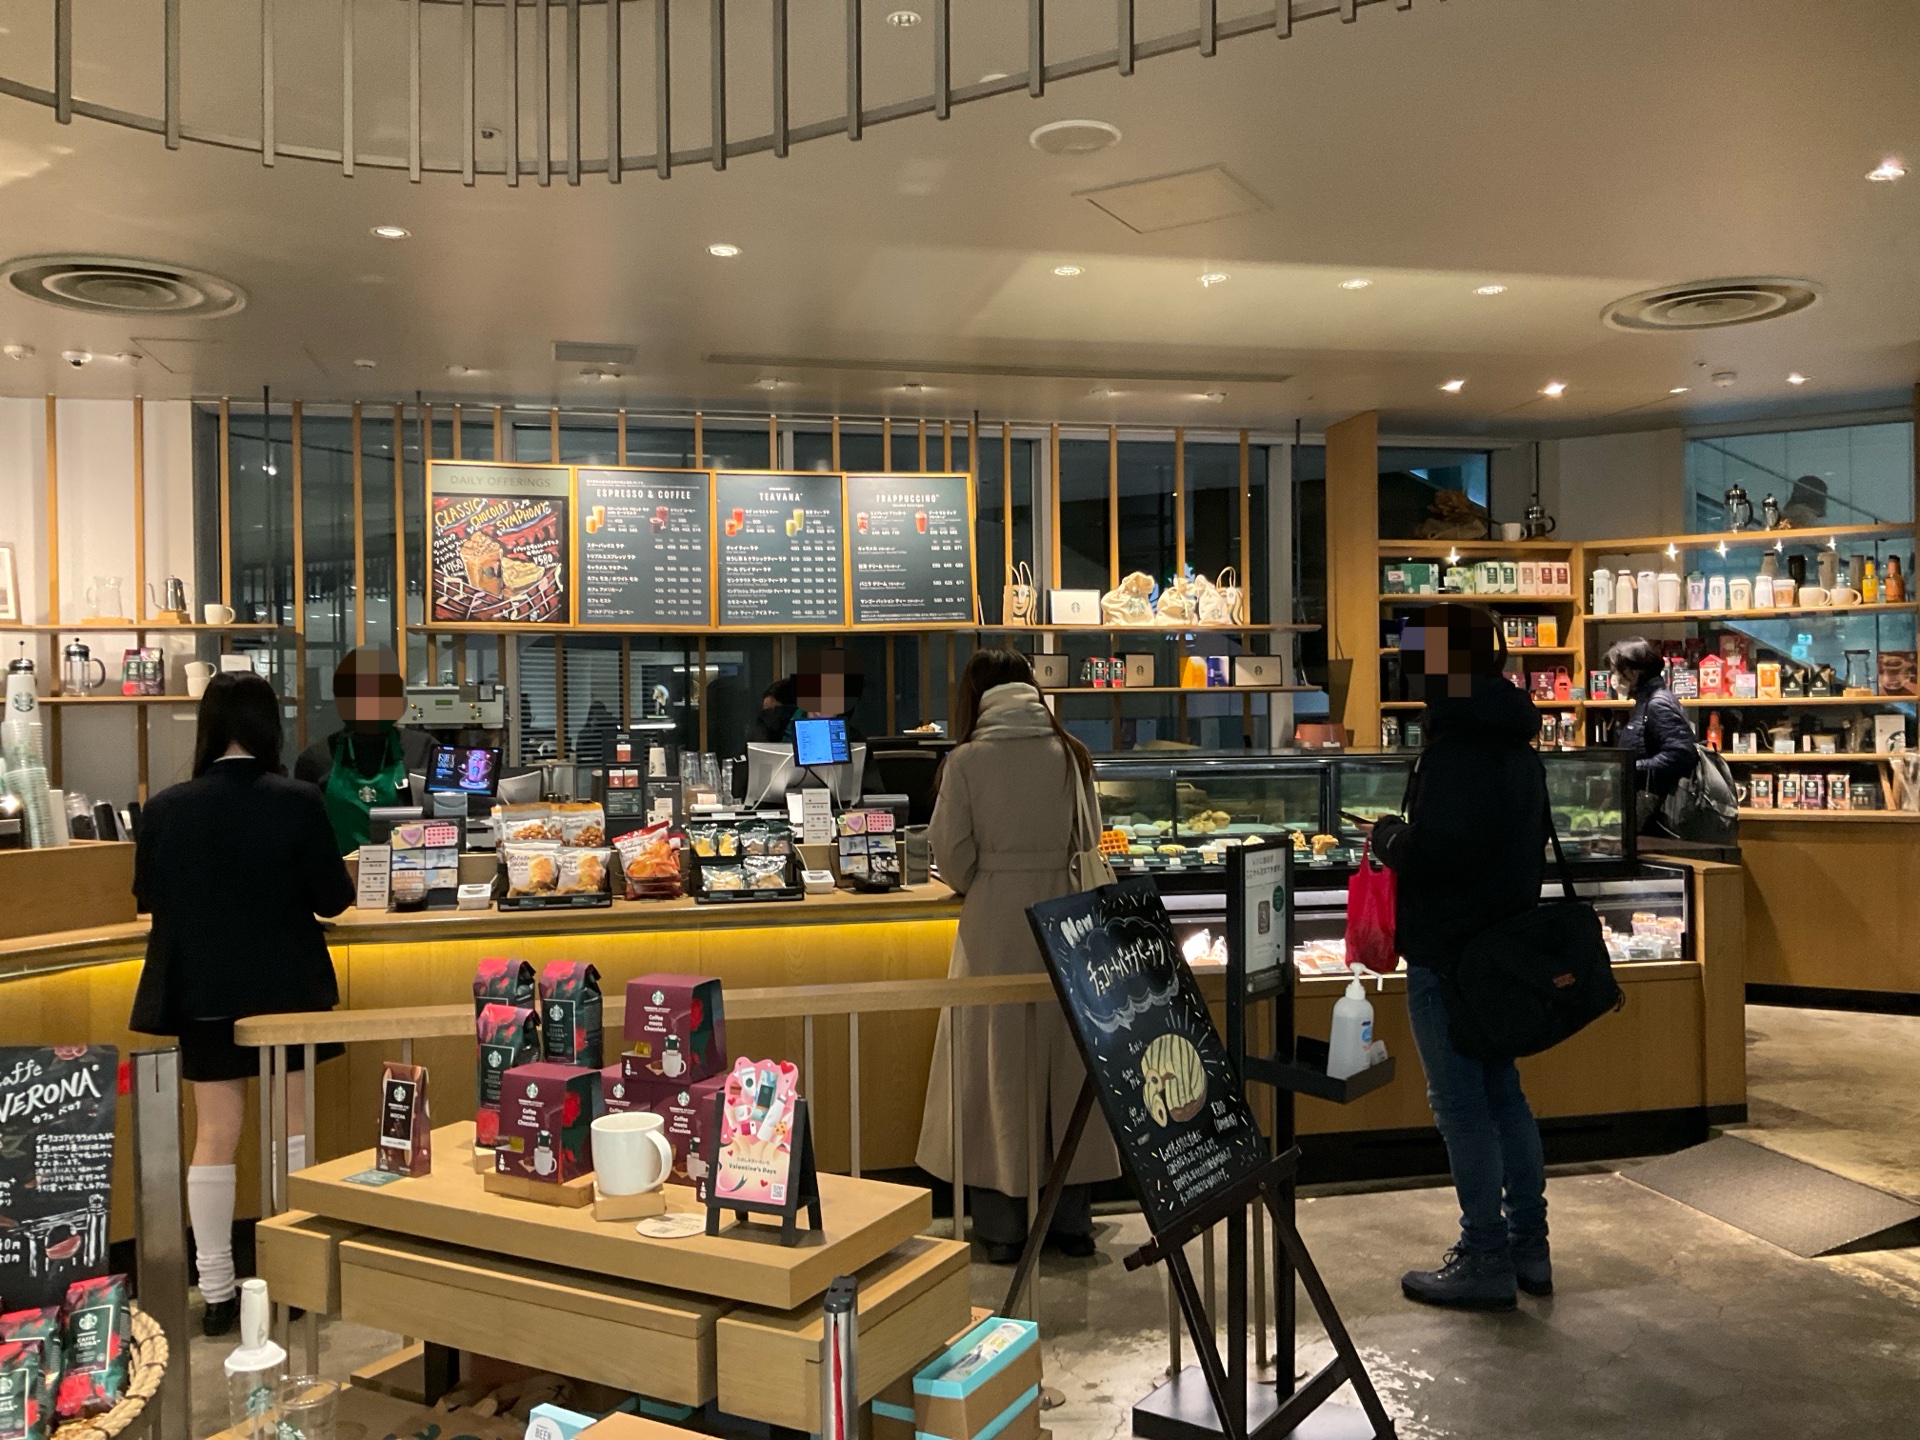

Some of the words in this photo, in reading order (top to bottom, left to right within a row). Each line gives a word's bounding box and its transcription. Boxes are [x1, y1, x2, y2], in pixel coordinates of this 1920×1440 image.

[450, 475, 483, 485] DAILY
[487, 477, 551, 487] OFFERINGS
[596, 488, 643, 498] ESPRESSO
[647, 490, 654, 499] &
[657, 490, 691, 500] COFFEE
[759, 492, 800, 502] TEAVANA
[876, 494, 937, 503] FRAPPUCCINO
[435, 497, 481, 528] CLASSIC
[470, 500, 510, 527] CHOCOLAT
[496, 501, 549, 531] SYMPHONY
[1060, 913, 1094, 949] New
[0, 1059, 43, 1088] affe
[389, 1112, 406, 1120] MOCHA
[673, 1115, 689, 1123] Coffee
[668, 1126, 692, 1135] Chocolate
[729, 1162, 762, 1173] Valentine's
[762, 1167, 777, 1175] Days
[534, 1427, 553, 1440] BEEN
